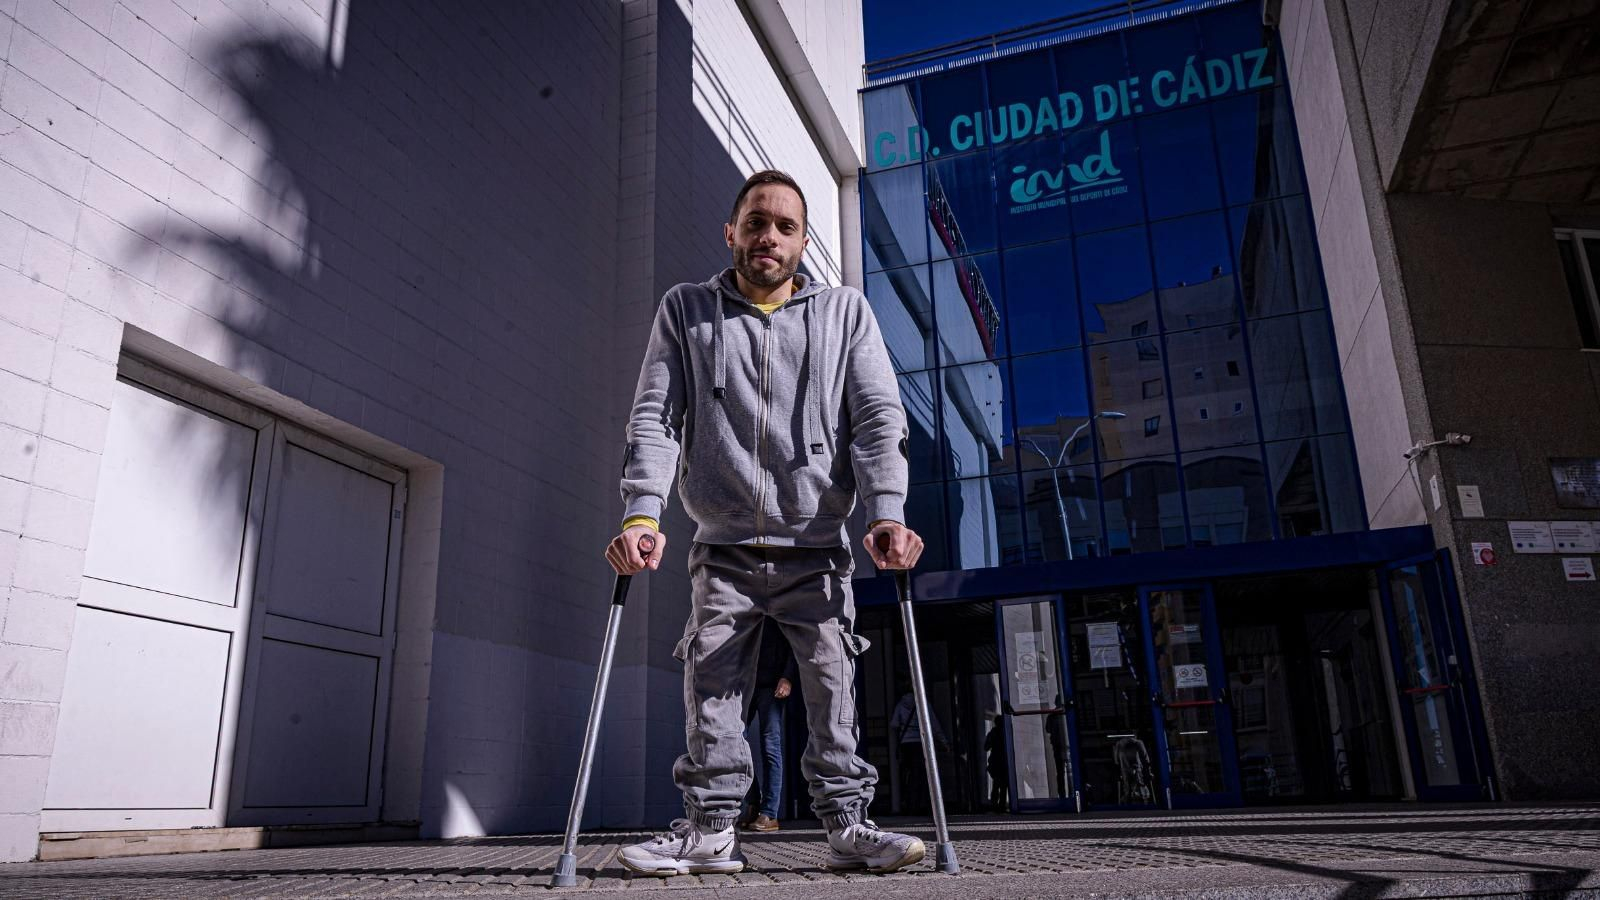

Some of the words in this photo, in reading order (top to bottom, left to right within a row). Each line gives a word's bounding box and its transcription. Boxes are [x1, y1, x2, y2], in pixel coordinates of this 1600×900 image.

[874, 124, 940, 168] C.D.
[950, 92, 1084, 151] CIUDAD
[1093, 76, 1143, 122] DE
[1152, 47, 1274, 107] CÁDIZ
